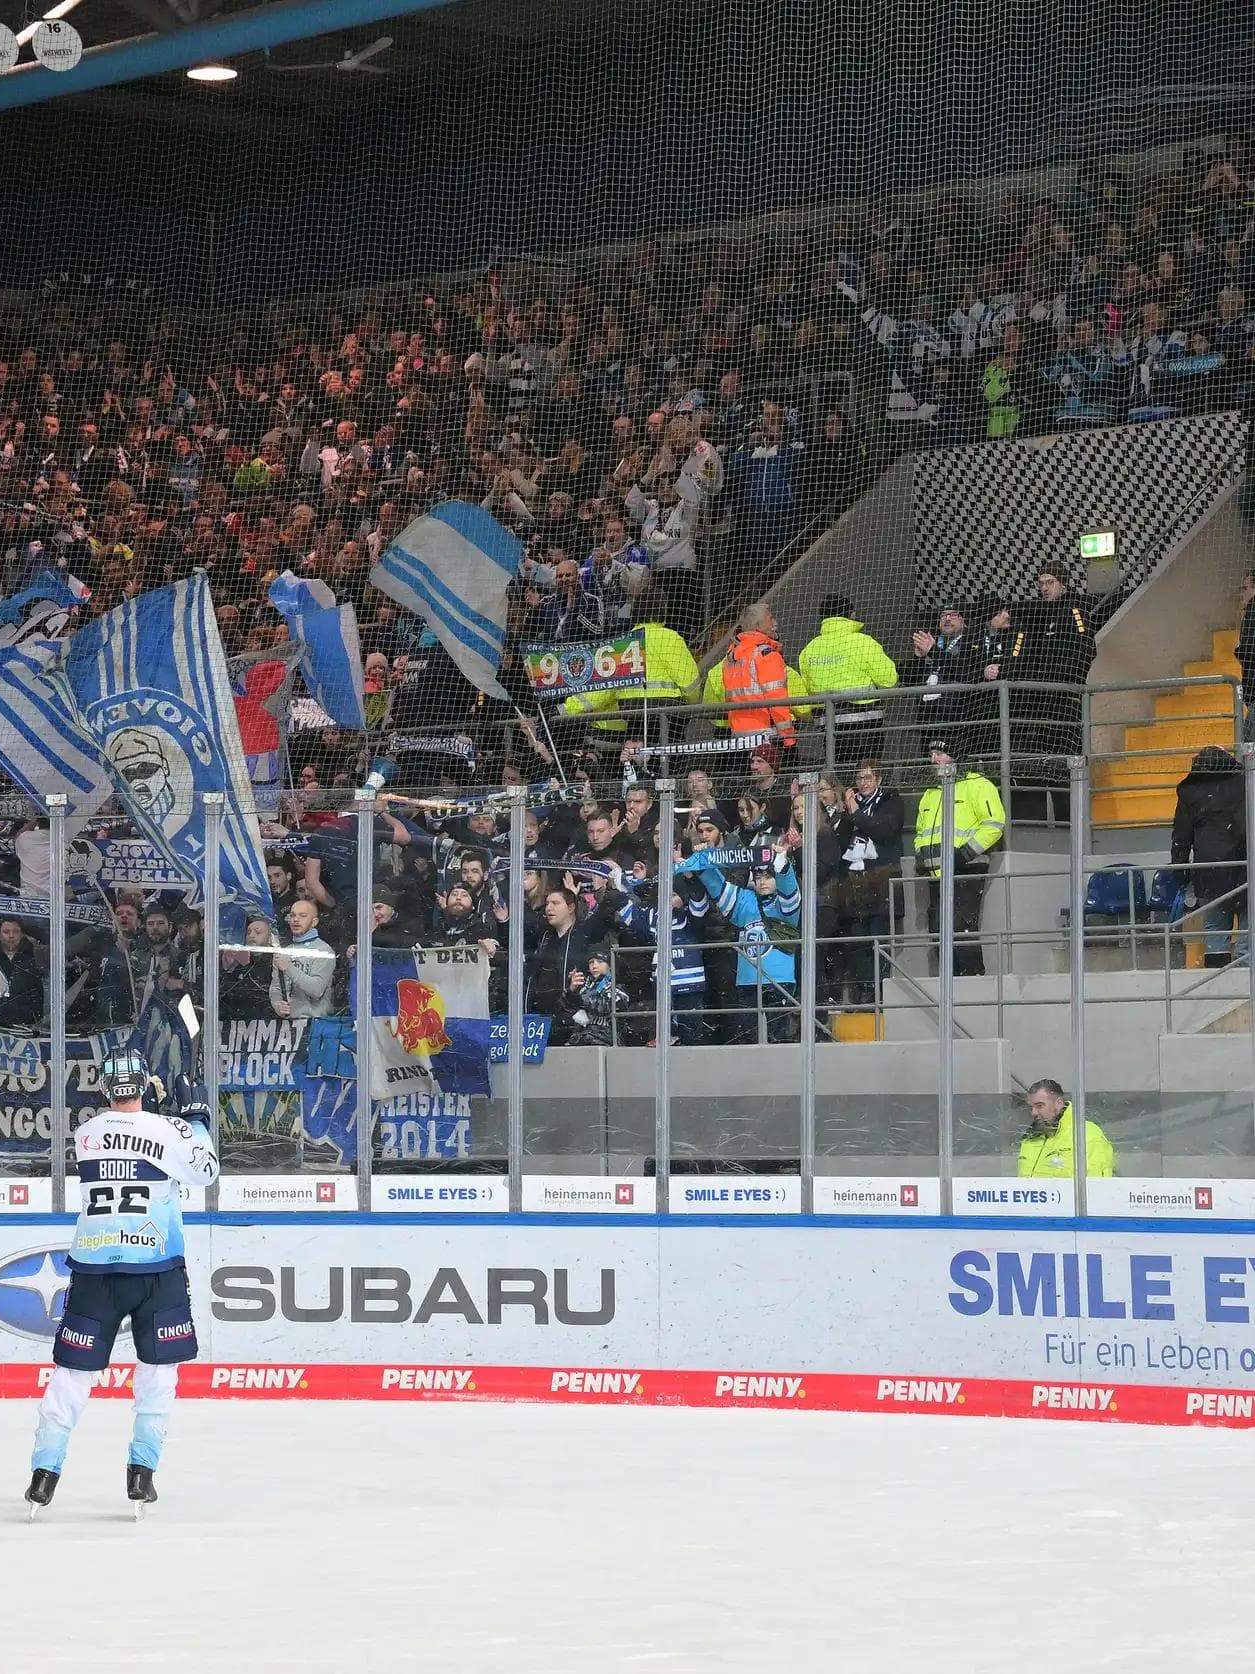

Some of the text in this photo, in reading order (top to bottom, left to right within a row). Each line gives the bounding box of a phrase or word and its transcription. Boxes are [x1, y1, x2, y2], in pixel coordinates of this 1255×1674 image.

[46, 23, 61, 34] 16
[708, 848, 754, 864] MÜNCHEN
[436, 949, 479, 964] DEN
[218, 1019, 307, 1052] LIMMAT
[527, 1021, 545, 1040] 64
[218, 1053, 297, 1085] BLOCK
[103, 1133, 164, 1160] SATURN
[381, 1120, 471, 1158] 2014
[99, 1160, 138, 1180] BODIE
[243, 1186, 312, 1199] heinemann
[387, 1188, 433, 1200] SMILE
[438, 1188, 478, 1200] EYES
[544, 1188, 612, 1200] heinemann
[684, 1189, 729, 1201] SMILE
[733, 1189, 772, 1201] EYES
[832, 1188, 898, 1203] heinemann
[967, 1191, 1009, 1203] SMILE
[1012, 1191, 1048, 1204] EYES
[1129, 1191, 1192, 1205] heinemann
[77, 1228, 157, 1250] zieglerhaus
[947, 1249, 1176, 1321] SMILE
[210, 1265, 617, 1325] SUBARU
[61, 1326, 95, 1347] CINQUE
[157, 1321, 193, 1339] CINQUE
[1045, 1333, 1086, 1365] Für
[1096, 1334, 1136, 1367] ein
[1146, 1335, 1229, 1372] Leben
[37, 1367, 134, 1388] PNY.
[1186, 1392, 1255, 1417] PENN
